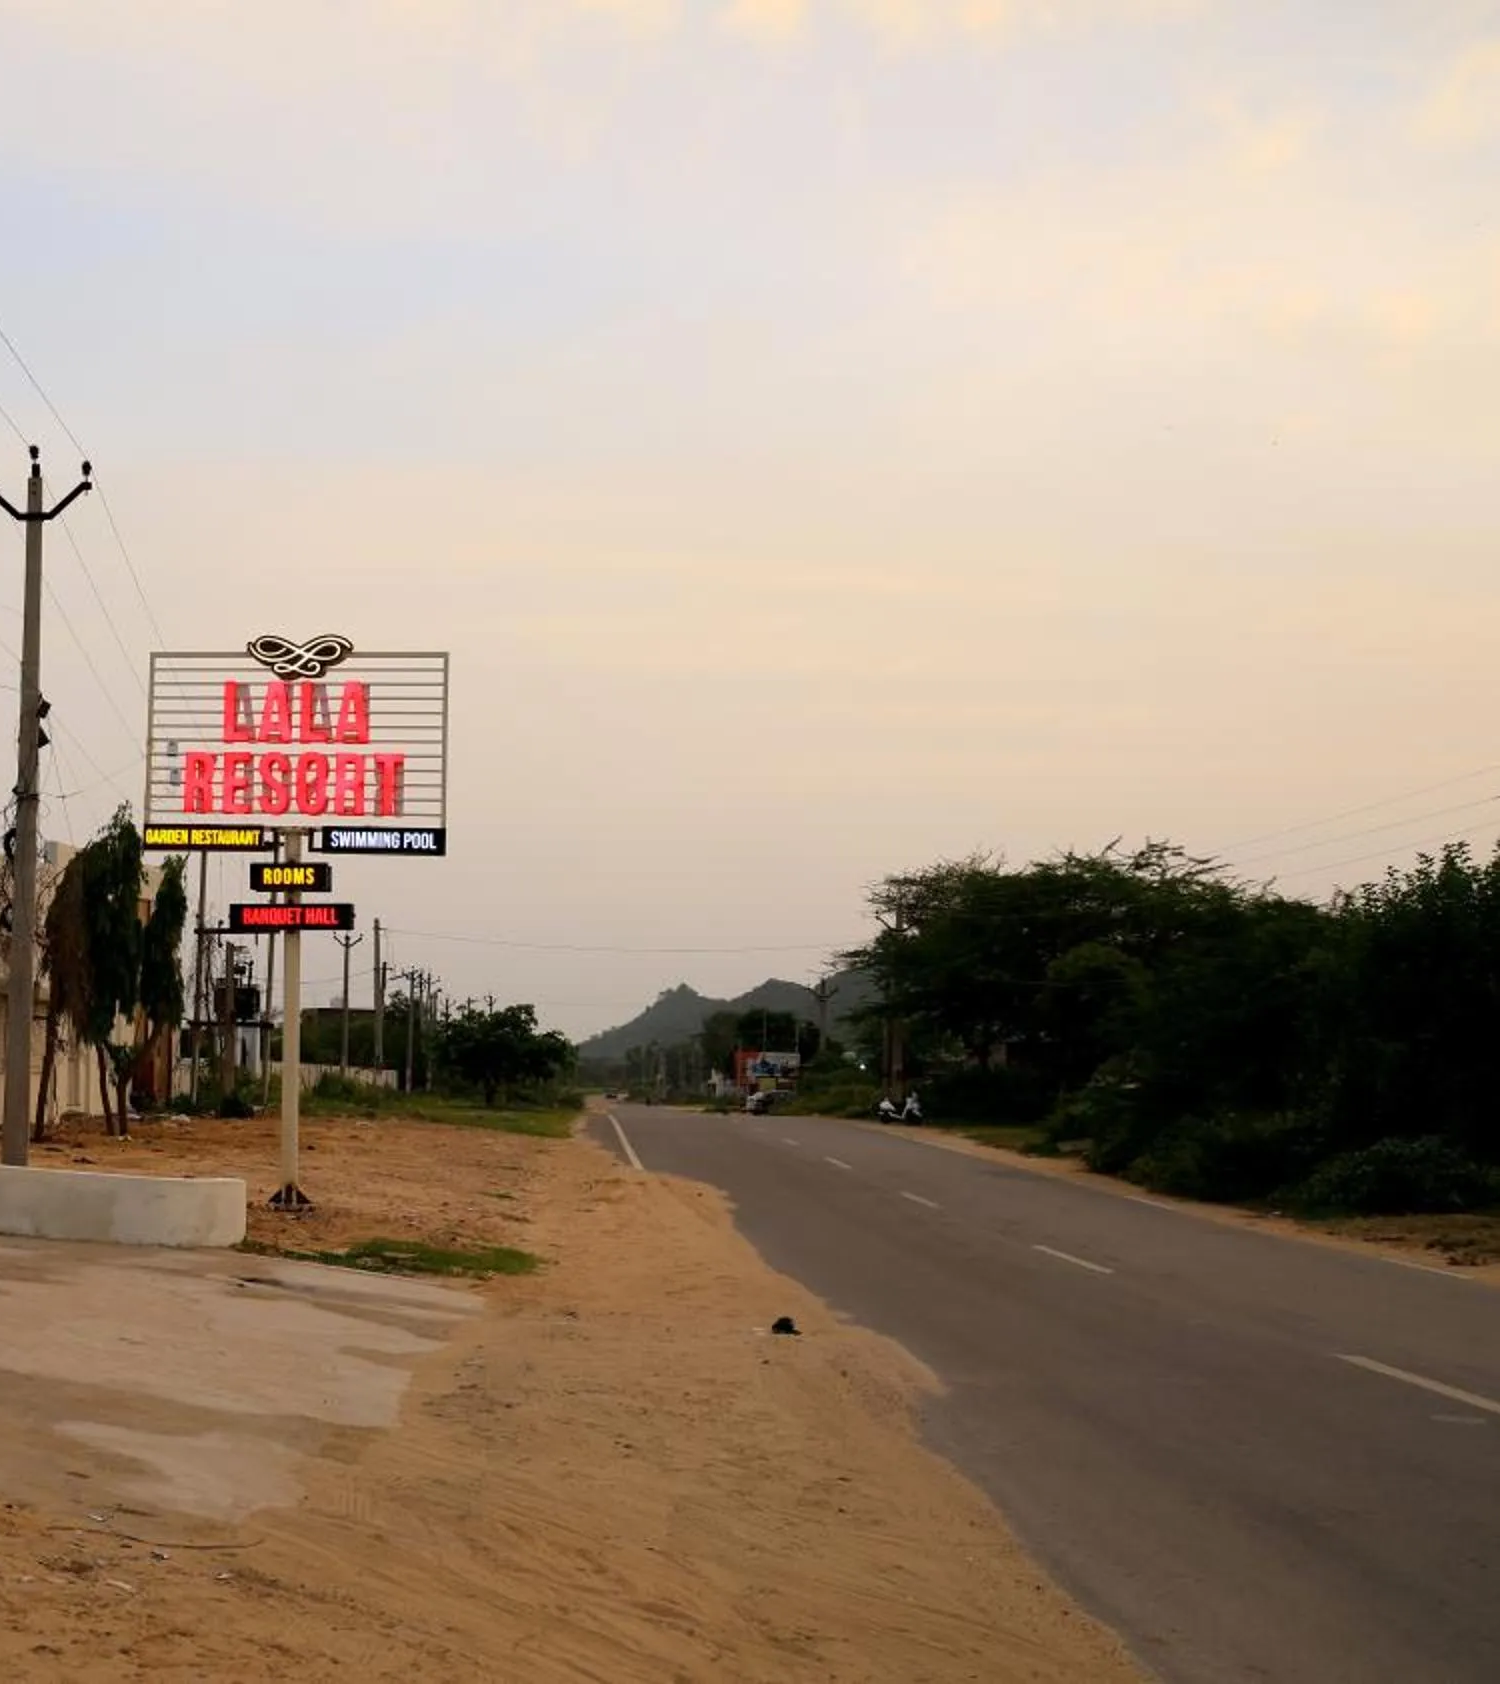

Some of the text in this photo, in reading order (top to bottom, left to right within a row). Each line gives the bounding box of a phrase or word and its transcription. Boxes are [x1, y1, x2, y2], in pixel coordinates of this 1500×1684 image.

[222, 680, 370, 744] LALA
[182, 751, 405, 817] RESORT
[145, 828, 261, 846] GARDEN RESTAURANT
[330, 831, 437, 850] SWIMMING POOL
[263, 867, 316, 885] ROOMS
[242, 907, 339, 925] BANQUET HALL
